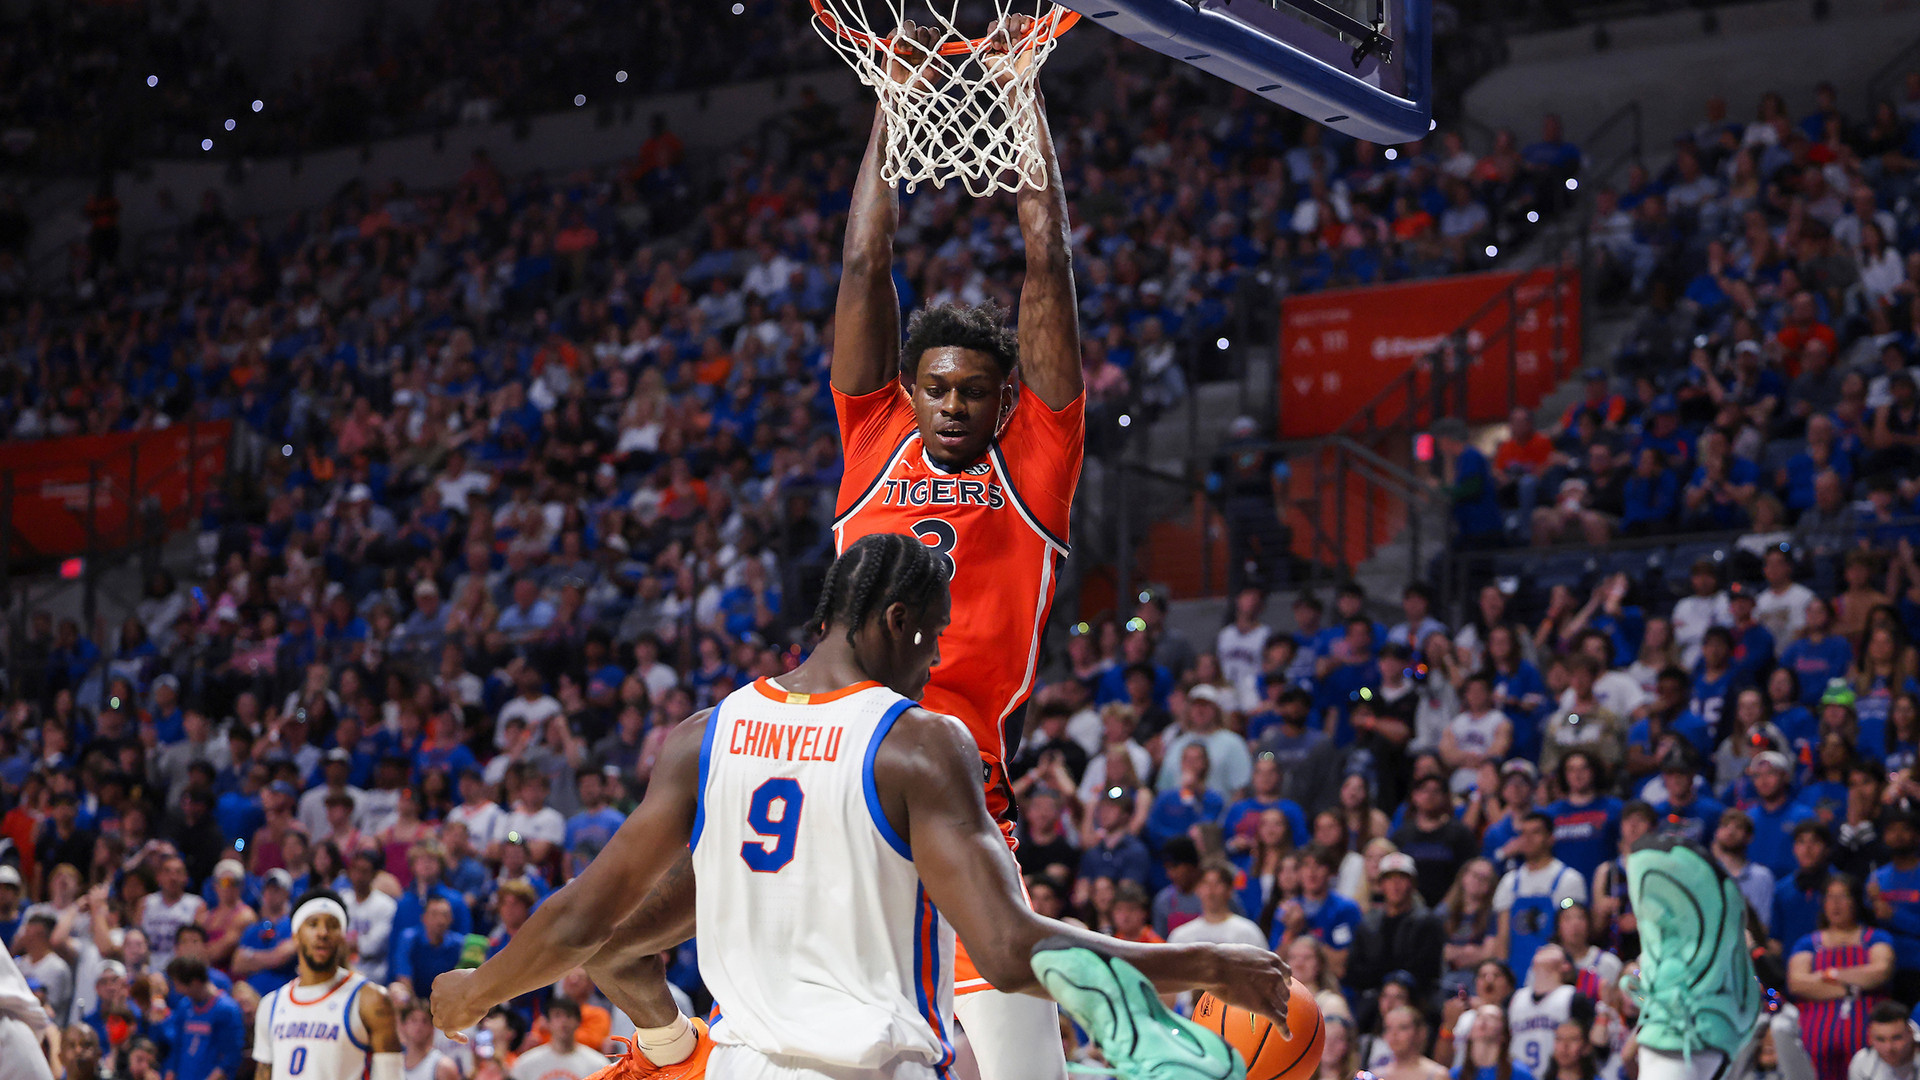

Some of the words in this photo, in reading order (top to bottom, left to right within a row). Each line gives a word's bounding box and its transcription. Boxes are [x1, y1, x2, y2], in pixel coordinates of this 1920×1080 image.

[965, 463, 991, 476] SEC
[882, 478, 1005, 510] TIGERS
[730, 719, 843, 762] CHINYELU
[740, 777, 805, 873] 9
[274, 1022, 339, 1040] FLORIDA
[290, 1047, 307, 1076] 0
